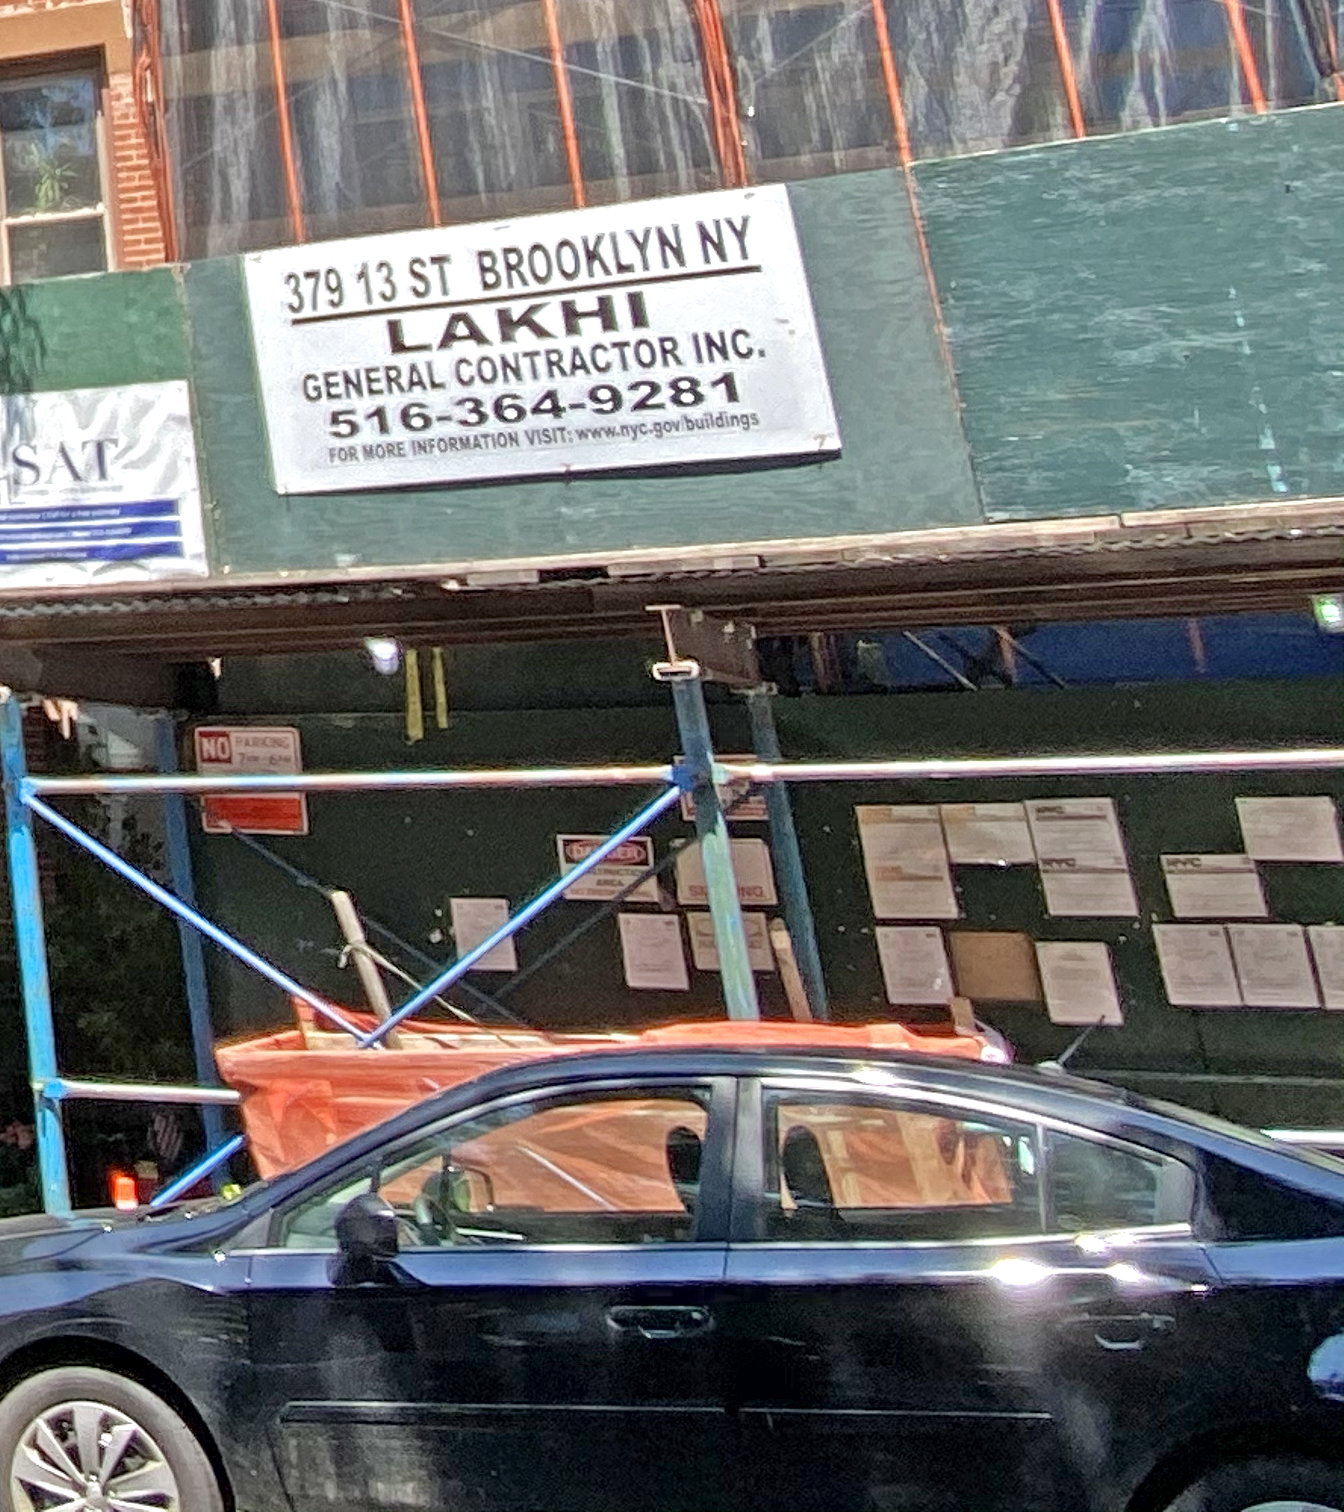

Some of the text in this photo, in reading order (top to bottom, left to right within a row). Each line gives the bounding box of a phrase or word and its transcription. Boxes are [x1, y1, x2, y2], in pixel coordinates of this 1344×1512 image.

[285, 215, 750, 314] 379 13 ST BROOKLYN NY
[387, 290, 650, 354] LAKHI
[303, 329, 765, 402] GENERAL CONTRACTOR INC.
[329, 371, 740, 438] 516-364-9281
[12, 438, 119, 486] SAT
[328, 411, 760, 463] FOR MORE INFORMATION VISIT: www.nyc.gov/buildings
[201, 736, 231, 761] NO
